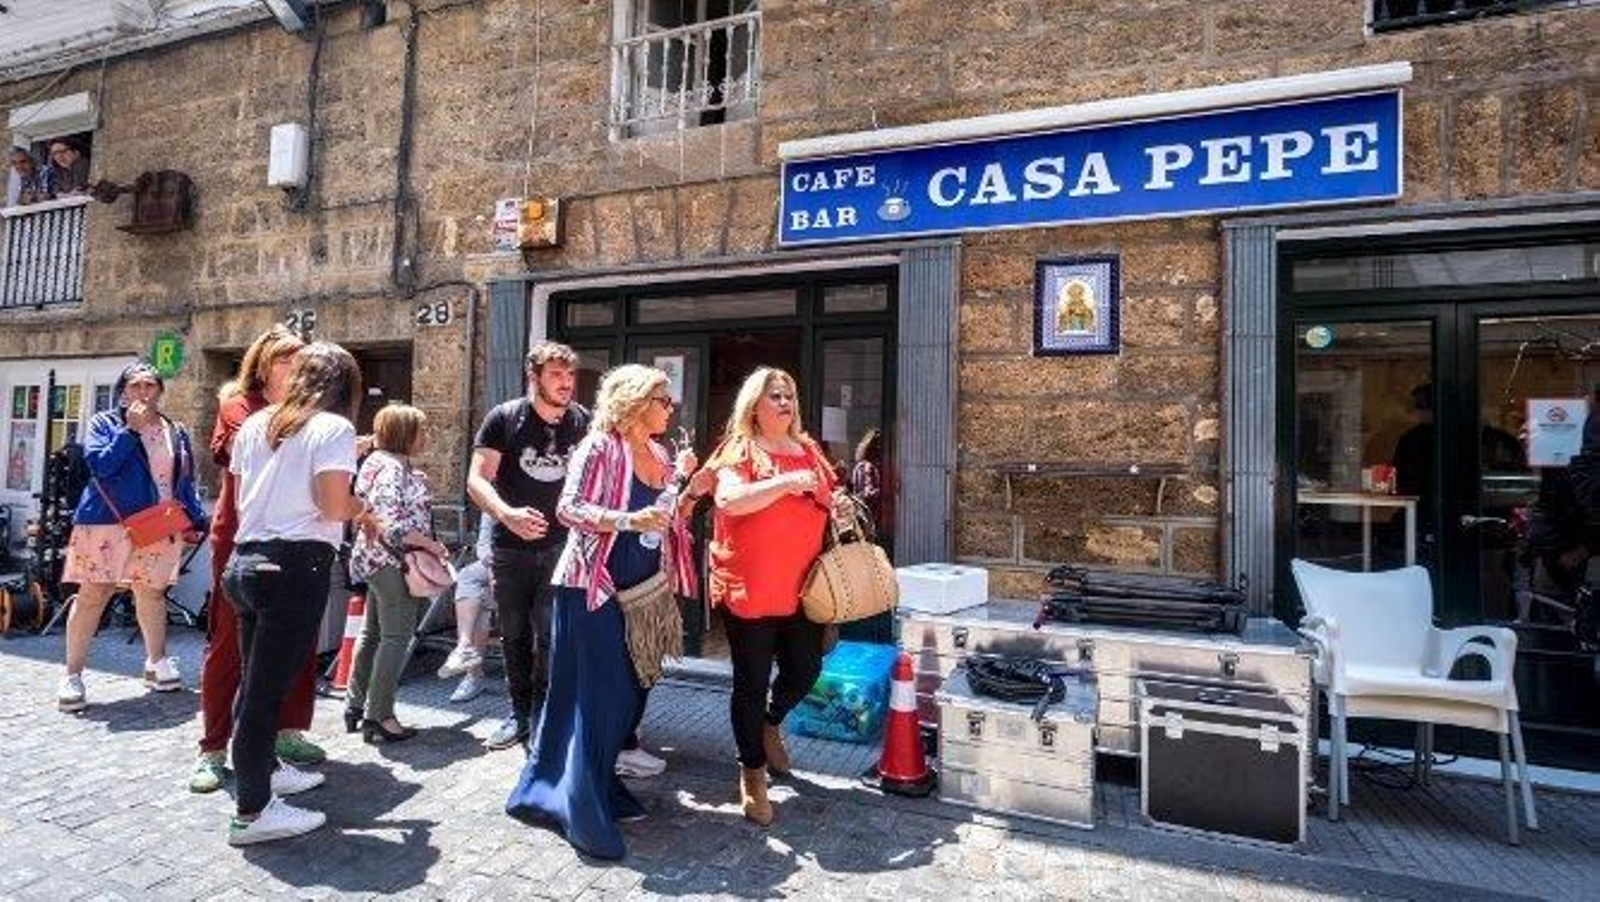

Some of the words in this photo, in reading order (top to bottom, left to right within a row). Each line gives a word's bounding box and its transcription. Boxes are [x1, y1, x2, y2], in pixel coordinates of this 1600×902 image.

[927, 152, 1120, 207] CASA
[1143, 122, 1379, 190] PEPE
[792, 164, 876, 192] CAFE
[790, 206, 859, 230] BAR
[286, 310, 316, 332] 26
[417, 300, 450, 324] 28
[157, 339, 174, 369] R
